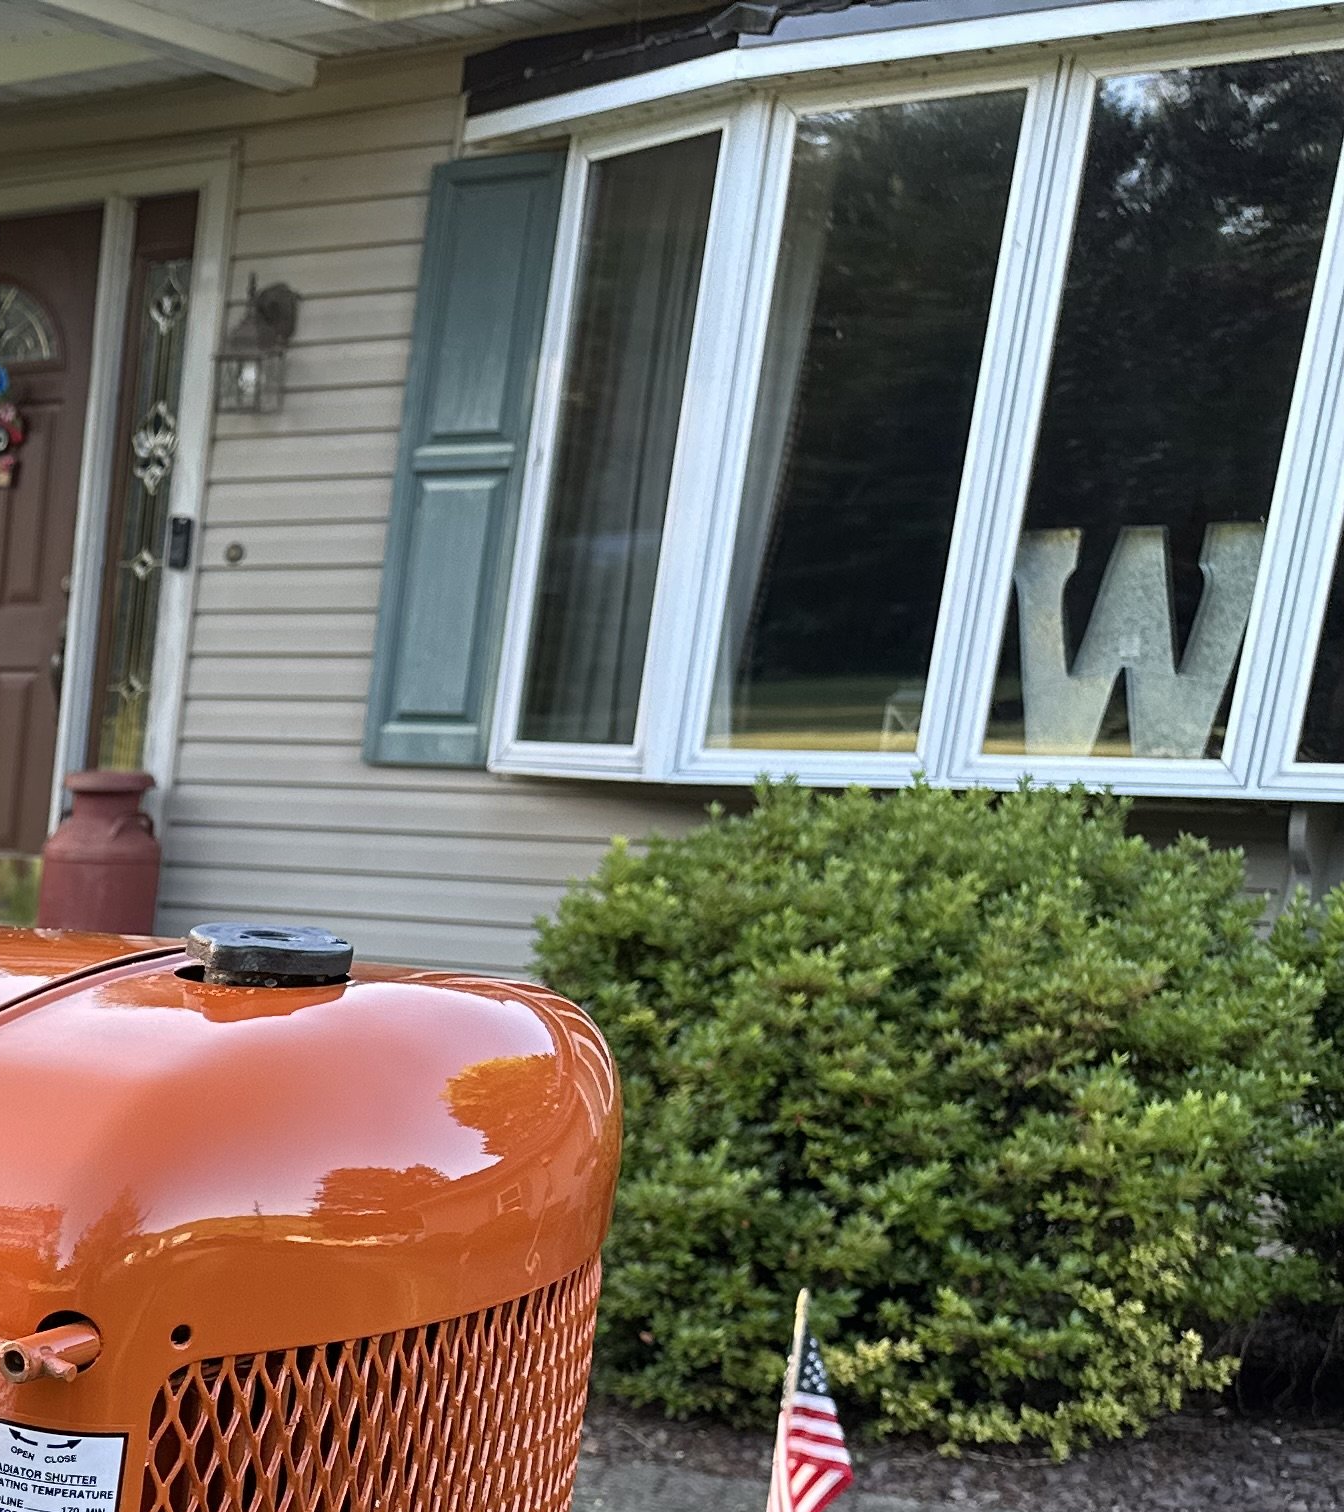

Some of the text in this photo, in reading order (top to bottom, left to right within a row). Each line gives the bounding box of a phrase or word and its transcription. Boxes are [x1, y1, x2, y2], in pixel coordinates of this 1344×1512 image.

[1014, 520, 1266, 758] W
[10, 1445, 77, 1464] OPEN CLOSE
[44, 1472, 97, 1485] SHUTTER
[32, 1484, 114, 1500] TEMPERATURE
